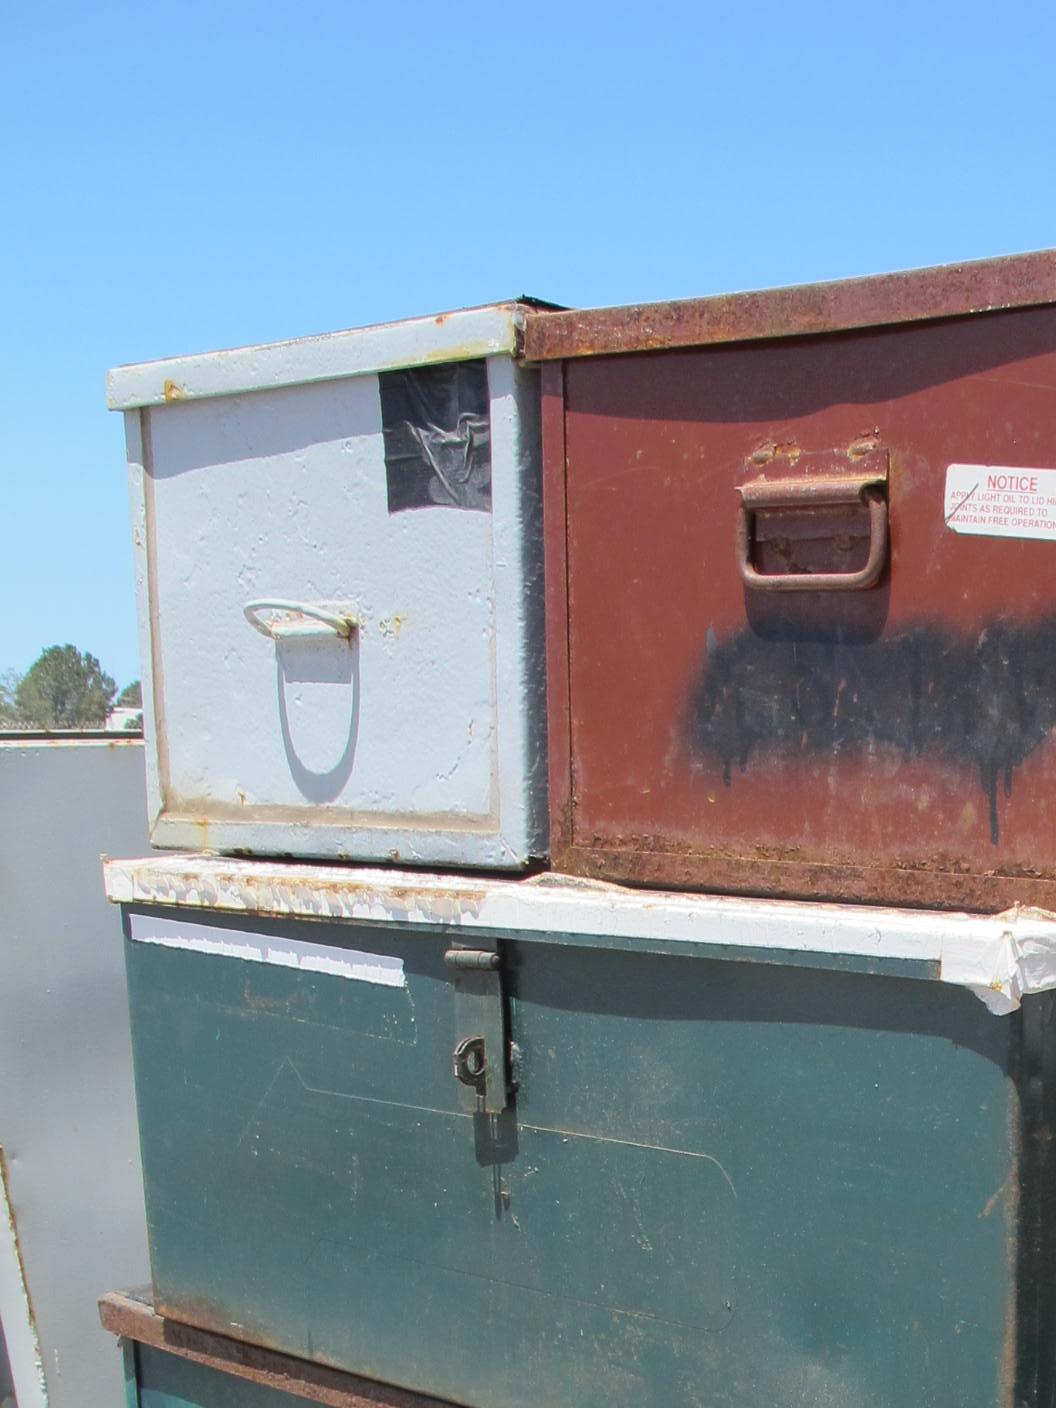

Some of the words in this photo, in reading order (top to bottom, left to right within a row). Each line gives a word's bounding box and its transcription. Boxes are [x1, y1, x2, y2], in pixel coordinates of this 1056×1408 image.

[987, 474, 1038, 491] NOTICE
[978, 492, 1001, 502] LIGHT
[1003, 494, 1015, 504] OIL
[1020, 495, 1030, 505] TO
[1032, 496, 1045, 506] LID
[979, 504, 991, 514] AS
[992, 506, 1035, 517] REQUIRED
[1038, 508, 1048, 518] TO
[987, 516, 1009, 526] FREE
